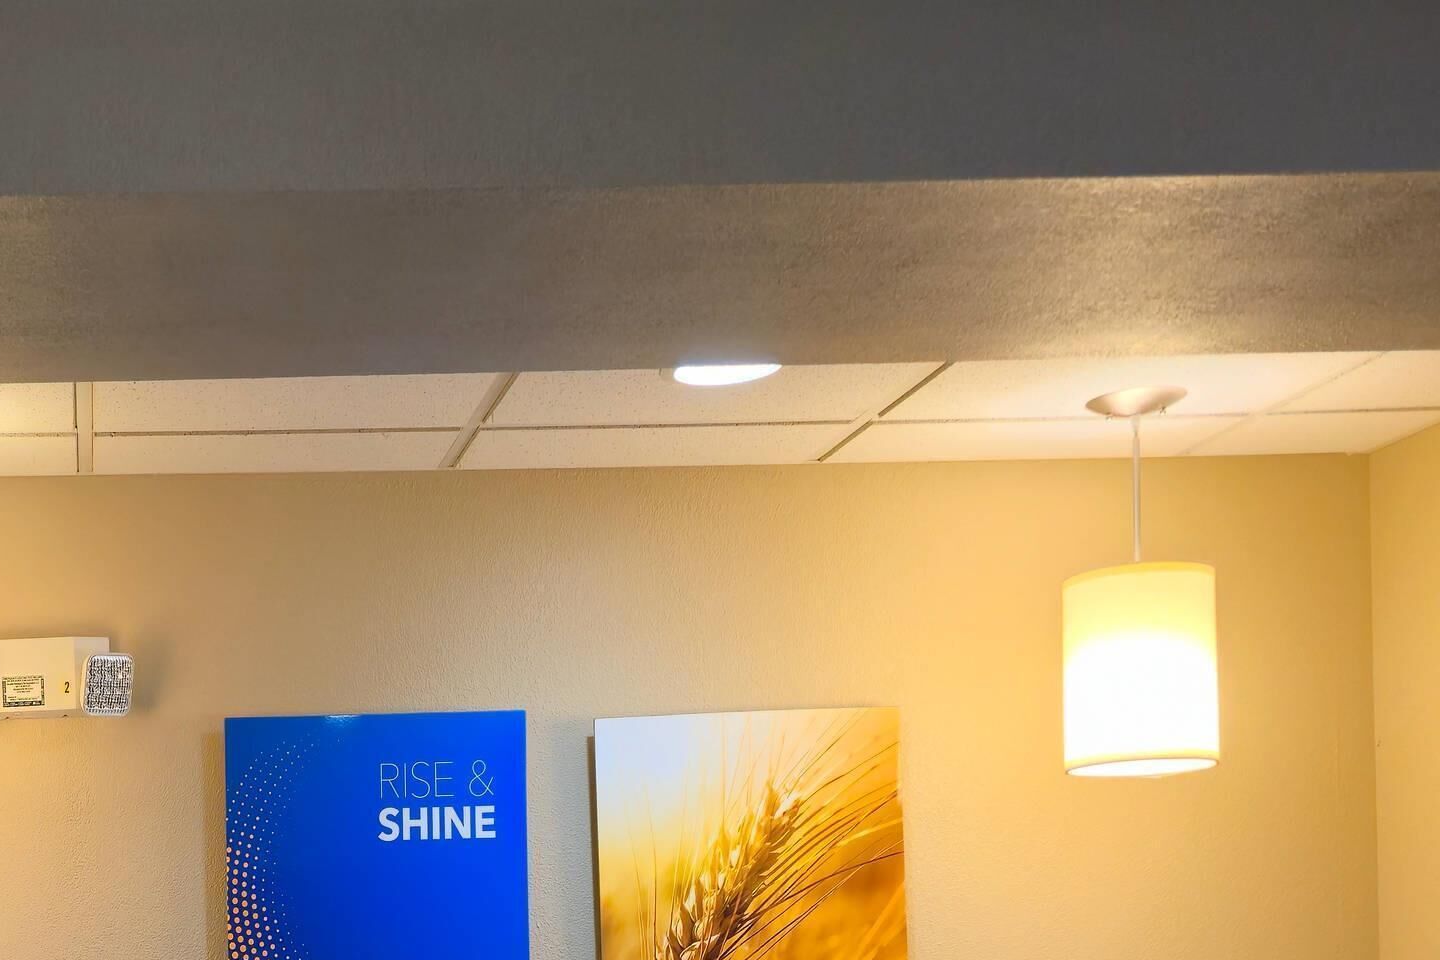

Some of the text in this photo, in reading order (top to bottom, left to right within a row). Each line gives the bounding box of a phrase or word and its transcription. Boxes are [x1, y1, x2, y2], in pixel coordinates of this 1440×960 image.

[64, 681, 70, 694] 2
[380, 759, 495, 799] RISE &
[378, 805, 497, 842] SHINE
